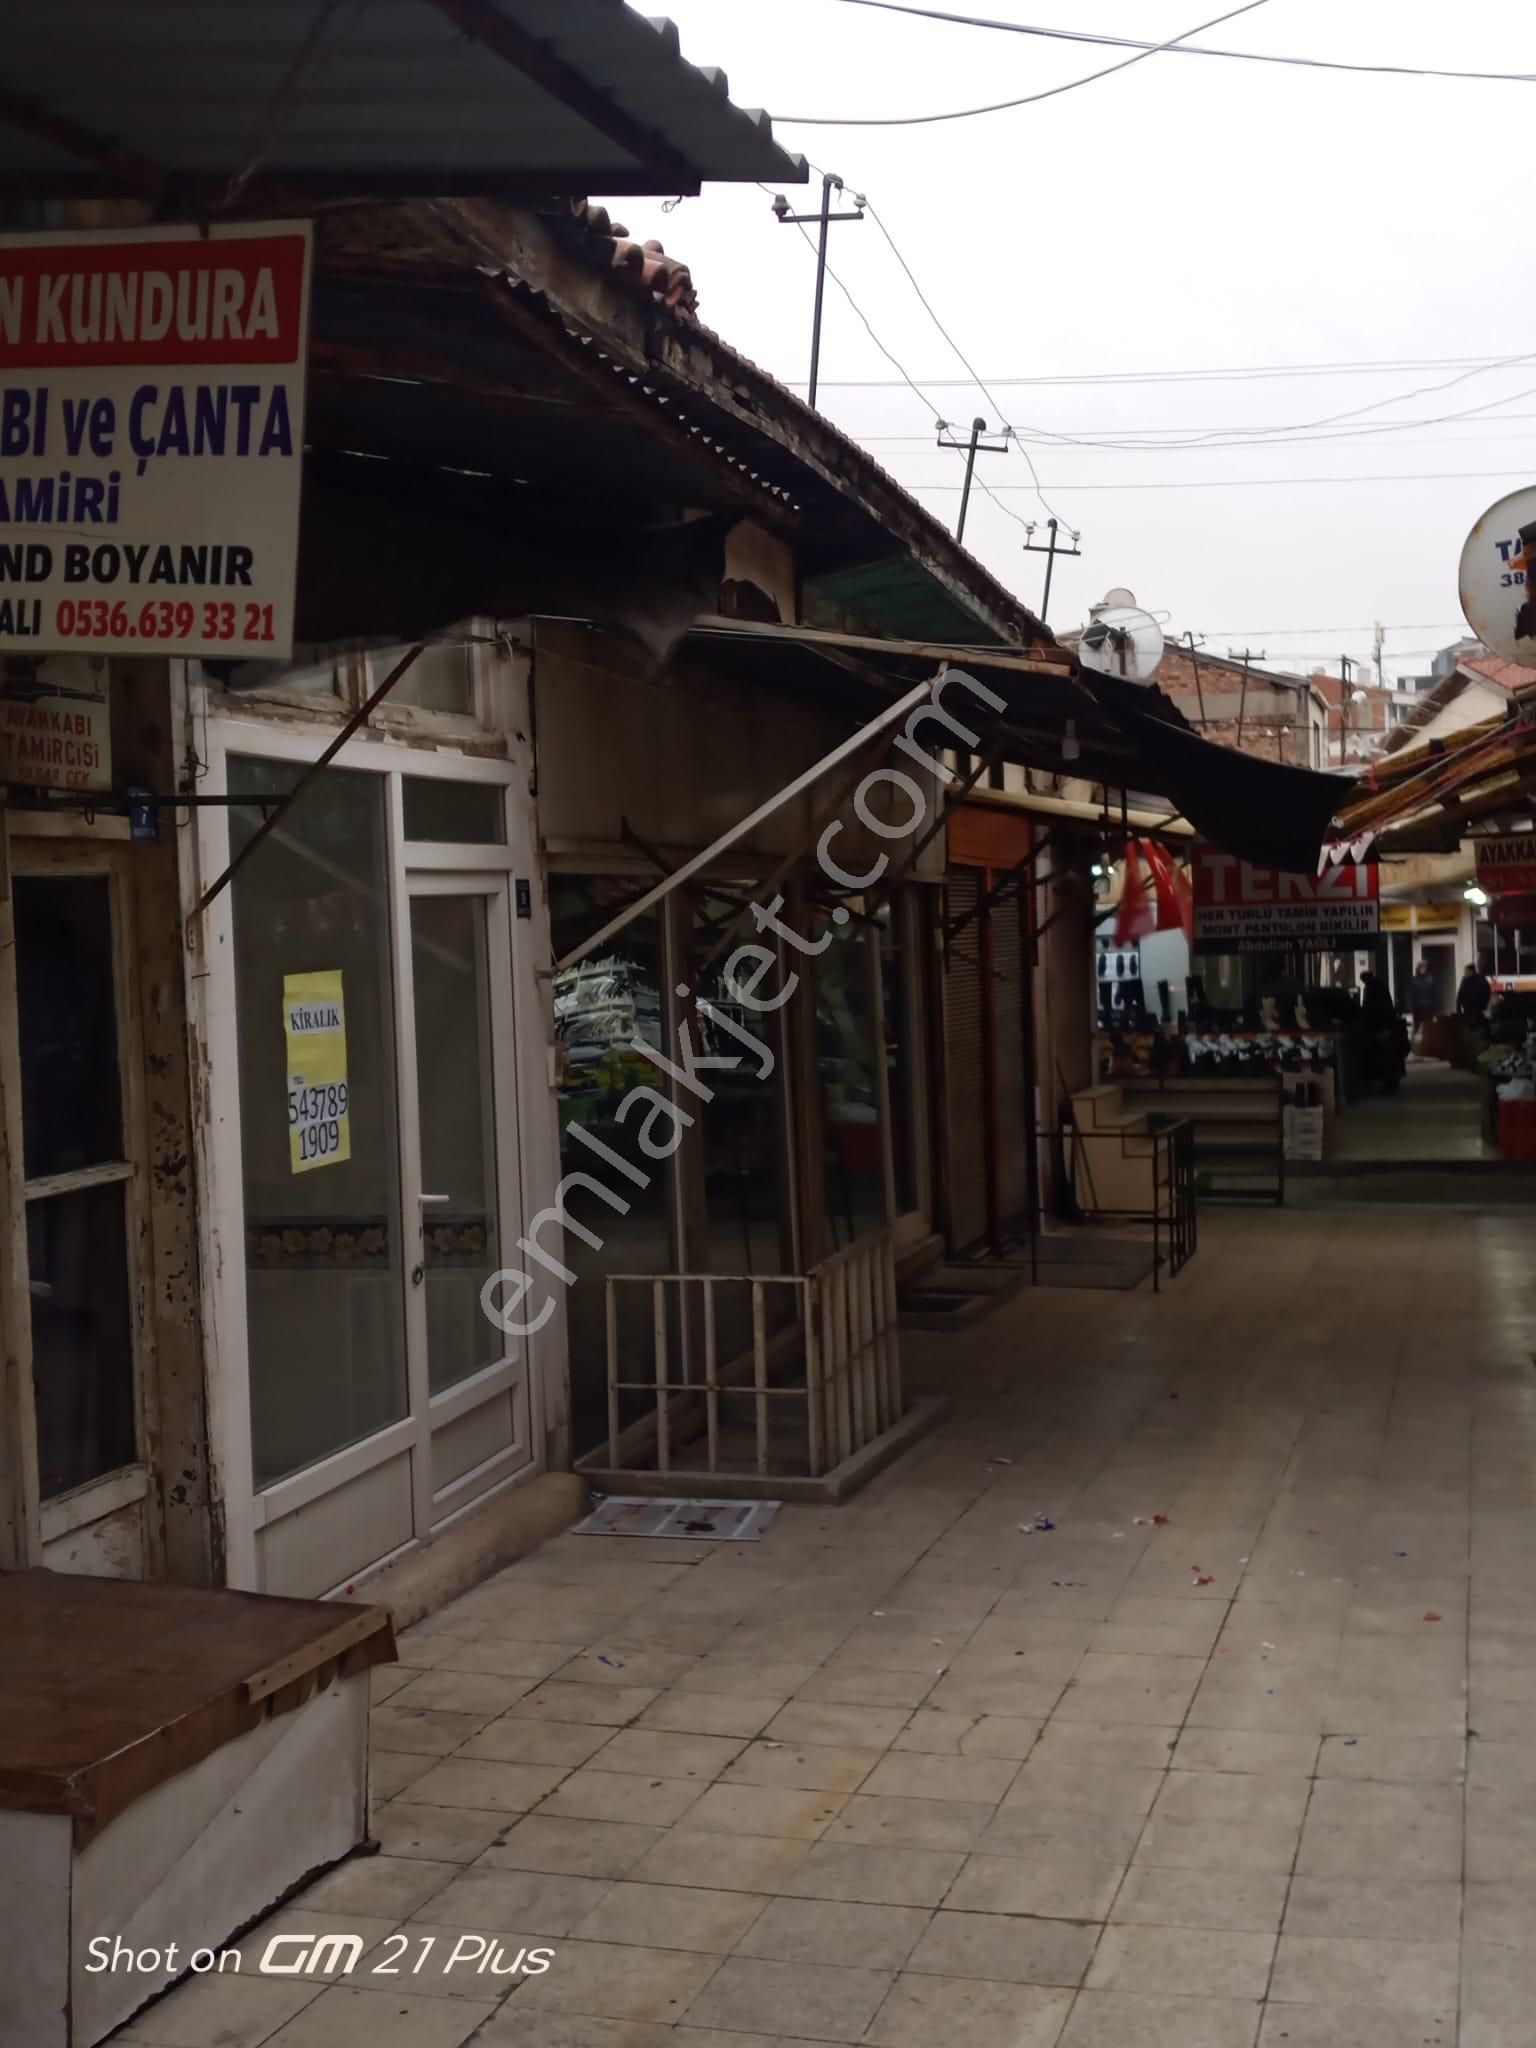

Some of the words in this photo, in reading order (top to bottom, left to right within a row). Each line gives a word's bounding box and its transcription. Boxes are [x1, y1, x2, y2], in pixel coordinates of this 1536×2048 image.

[36, 267, 279, 344] KUNDURA
[62, 397, 116, 457] ve
[129, 384, 293, 476] ÇANTA
[0, 543, 52, 582] ND
[64, 544, 254, 586] BOYANIR
[0, 599, 41, 635] ALI
[56, 600, 194, 638] 0536.639
[201, 602, 235, 640] 33
[243, 604, 275, 641] 21
[7, 705, 92, 737] AYAKKABI
[289, 1083, 348, 1124] 543789
[300, 1120, 340, 1160] 1909
